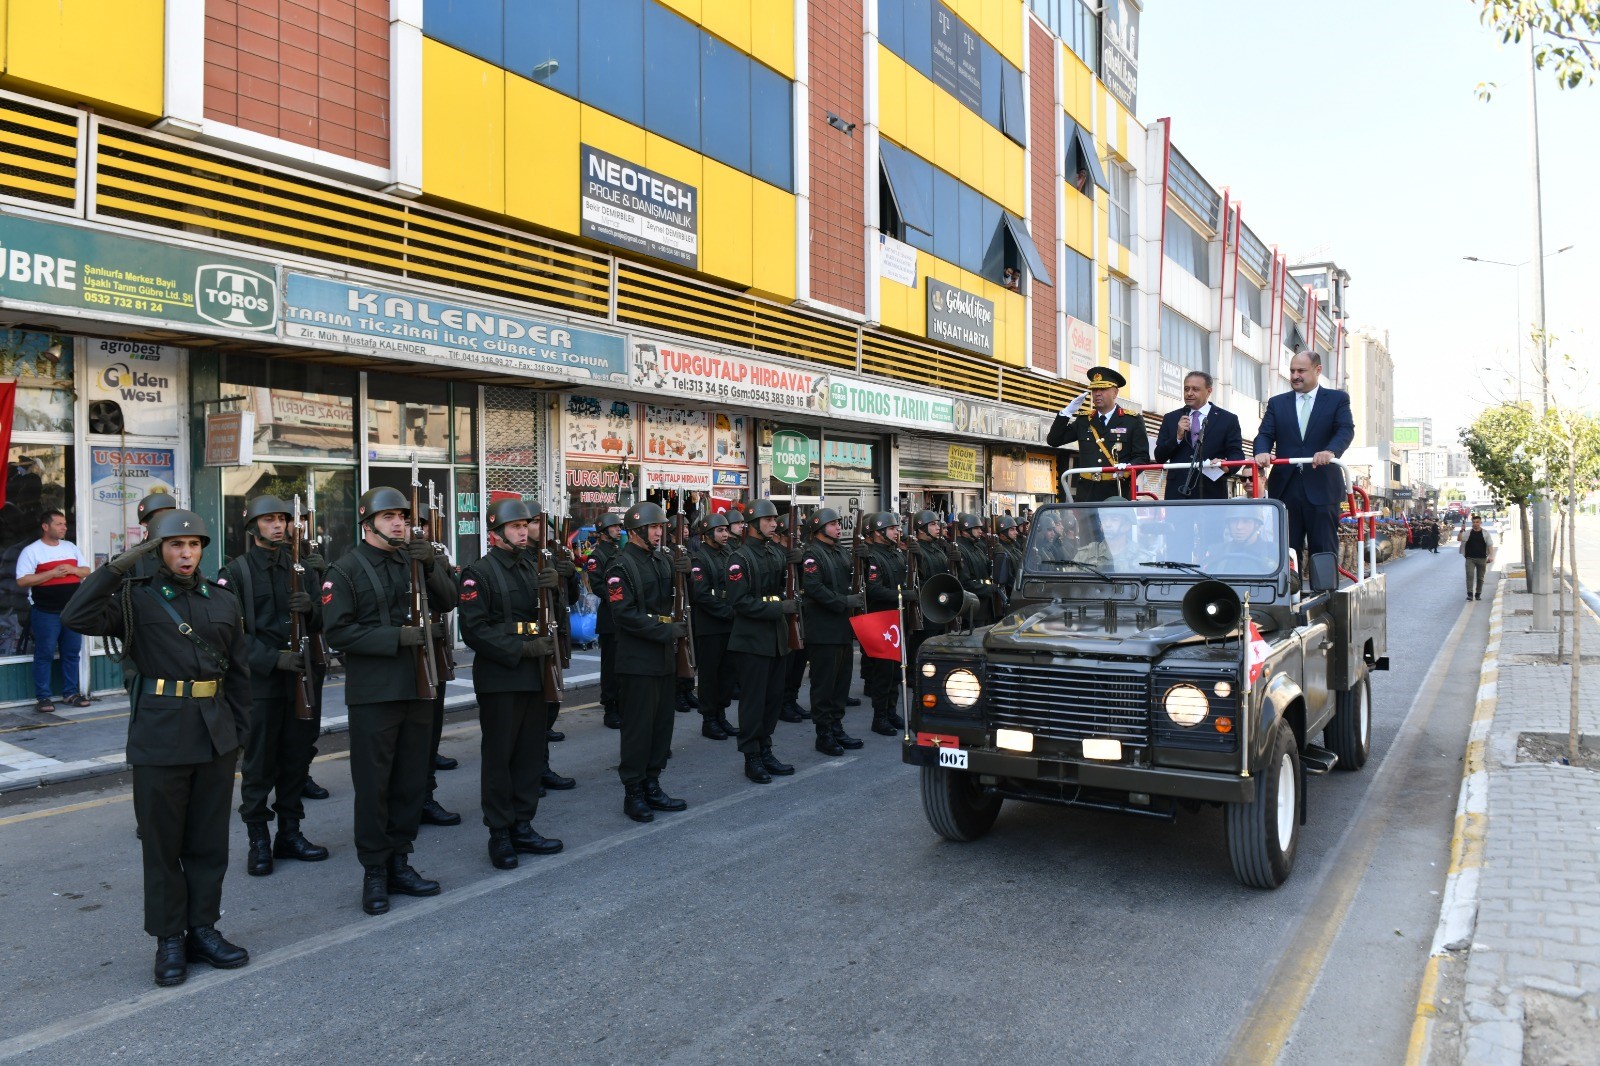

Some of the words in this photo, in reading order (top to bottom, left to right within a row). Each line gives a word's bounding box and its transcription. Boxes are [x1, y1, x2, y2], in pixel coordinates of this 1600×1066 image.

[589, 154, 692, 213] NEOTECH
[586, 200, 600, 212] Bekir
[589, 182, 620, 204] PROJE
[622, 194, 630, 207] &
[632, 197, 692, 228] DANIŞMANLIK
[646, 221, 665, 235] Zeynel
[0, 241, 76, 291] BRE
[84, 264, 123, 279] Şanlıurfa
[125, 271, 154, 285] Merkez
[156, 277, 176, 289] Bayii
[84, 276, 111, 289] Uşaklı
[113, 281, 136, 292] Tarım
[139, 286, 163, 297] Gübre
[166, 290, 181, 300] Ltd.
[183, 292, 193, 303] Şti
[205, 288, 269, 312] TOROS
[84, 292, 111, 305] 0532
[114, 297, 132, 308] 732
[135, 300, 147, 310] 81
[150, 303, 163, 312] 24
[348, 290, 572, 349] KALENDER
[100, 341, 160, 355] agrobest
[287, 306, 352, 327] TARIM
[444, 330, 478, 349] İLAÇ
[483, 339, 536, 357] GÜBRE
[540, 348, 557, 360] VE
[562, 352, 609, 368] TOHUM
[301, 328, 315, 338] Zir.
[343, 334, 377, 348] Mustafa
[380, 340, 426, 355] KALENDER
[519, 361, 533, 370] Fax:
[661, 349, 748, 383] TURGUTALP
[751, 366, 812, 394] HIRDAVAT
[121, 388, 162, 403] West
[705, 382, 716, 394] 34
[718, 383, 729, 396] 56
[771, 391, 785, 403] 383
[786, 393, 795, 406] 89
[797, 396, 804, 407] 16
[850, 388, 890, 417] TOROS
[894, 396, 929, 421] TARIM
[93, 450, 170, 469] UŞAKLI
[776, 452, 806, 465] TOROS
[949, 459, 972, 472] SATILIK
[113, 468, 149, 478] TARIM
[647, 472, 681, 482] TURGUTALP
[682, 473, 709, 484] HIRDAVAT
[458, 492, 480, 512] KAL
[940, 752, 966, 766] 007
